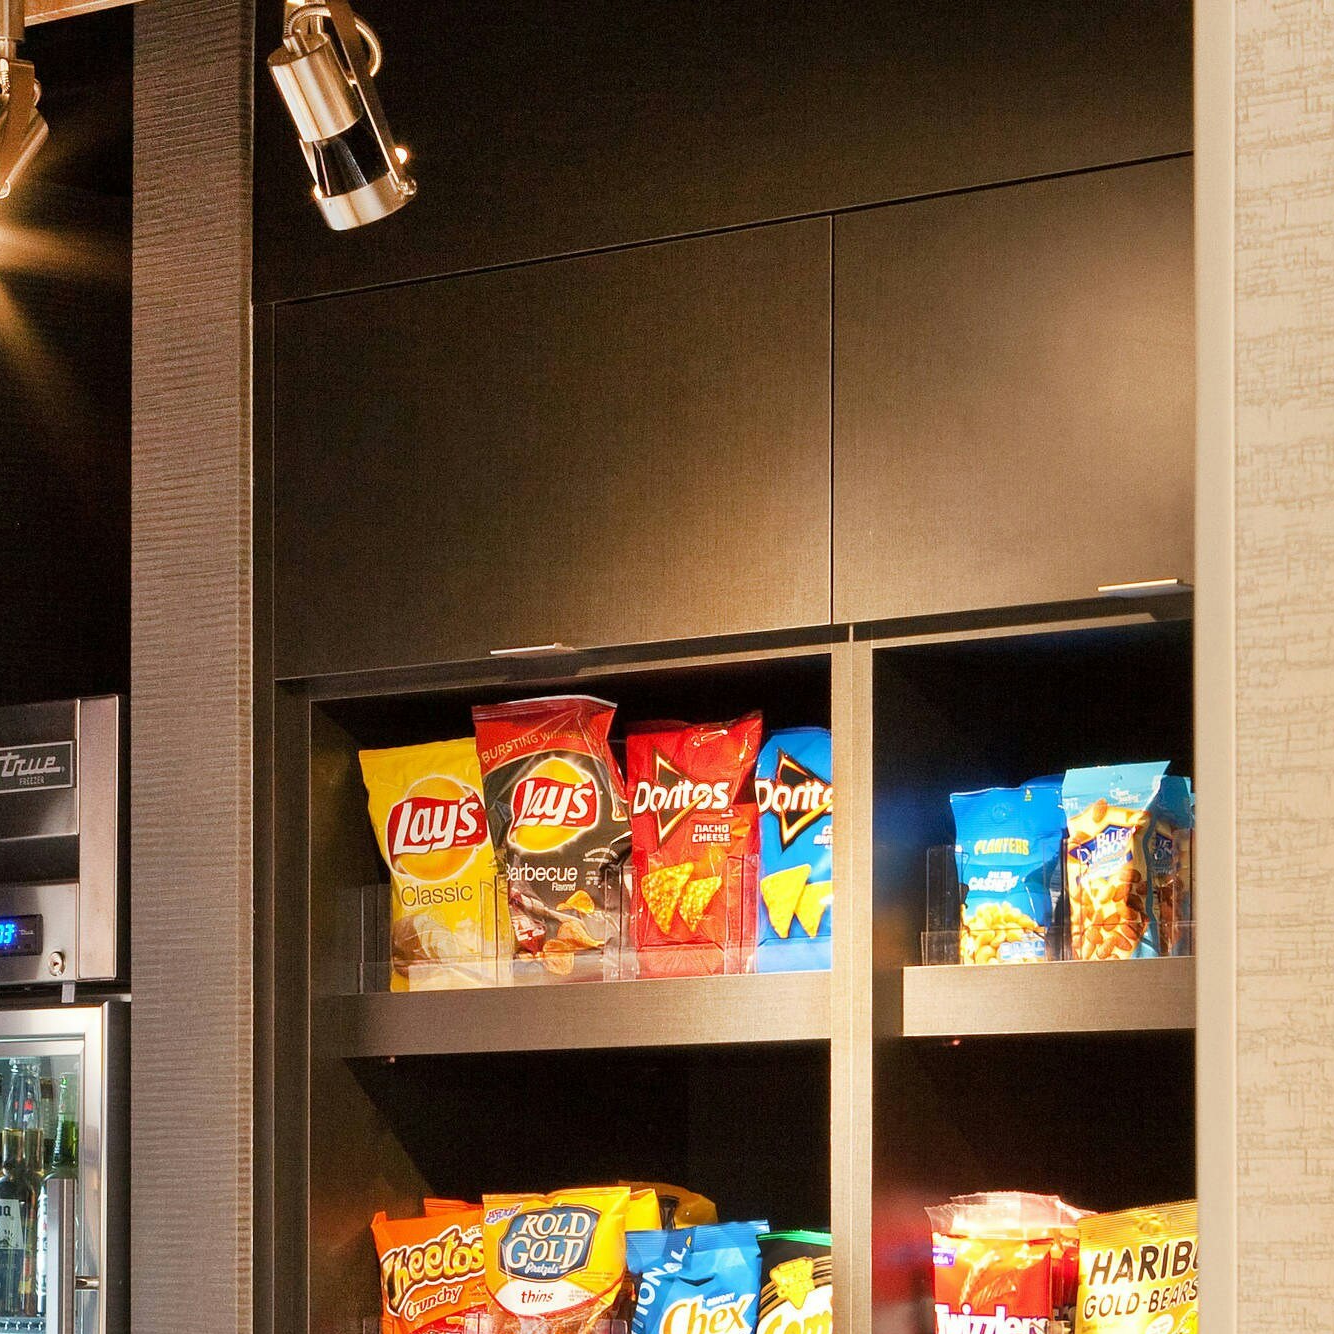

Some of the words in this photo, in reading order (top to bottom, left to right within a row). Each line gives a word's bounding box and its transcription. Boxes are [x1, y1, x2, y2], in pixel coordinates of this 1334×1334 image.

[481, 731, 539, 764] BURSTING
[515, 781, 593, 828] Lay's
[633, 781, 731, 815] Doritos
[393, 797, 479, 855] Lay's
[692, 833, 731, 844] CHEESE
[694, 824, 730, 834] NACHO
[401, 881, 473, 907] Classic
[518, 1212, 592, 1239] ROLD
[506, 1236, 585, 1270] GOLD
[405, 1285, 463, 1321] Crunchy
[521, 1289, 554, 1304] thins
